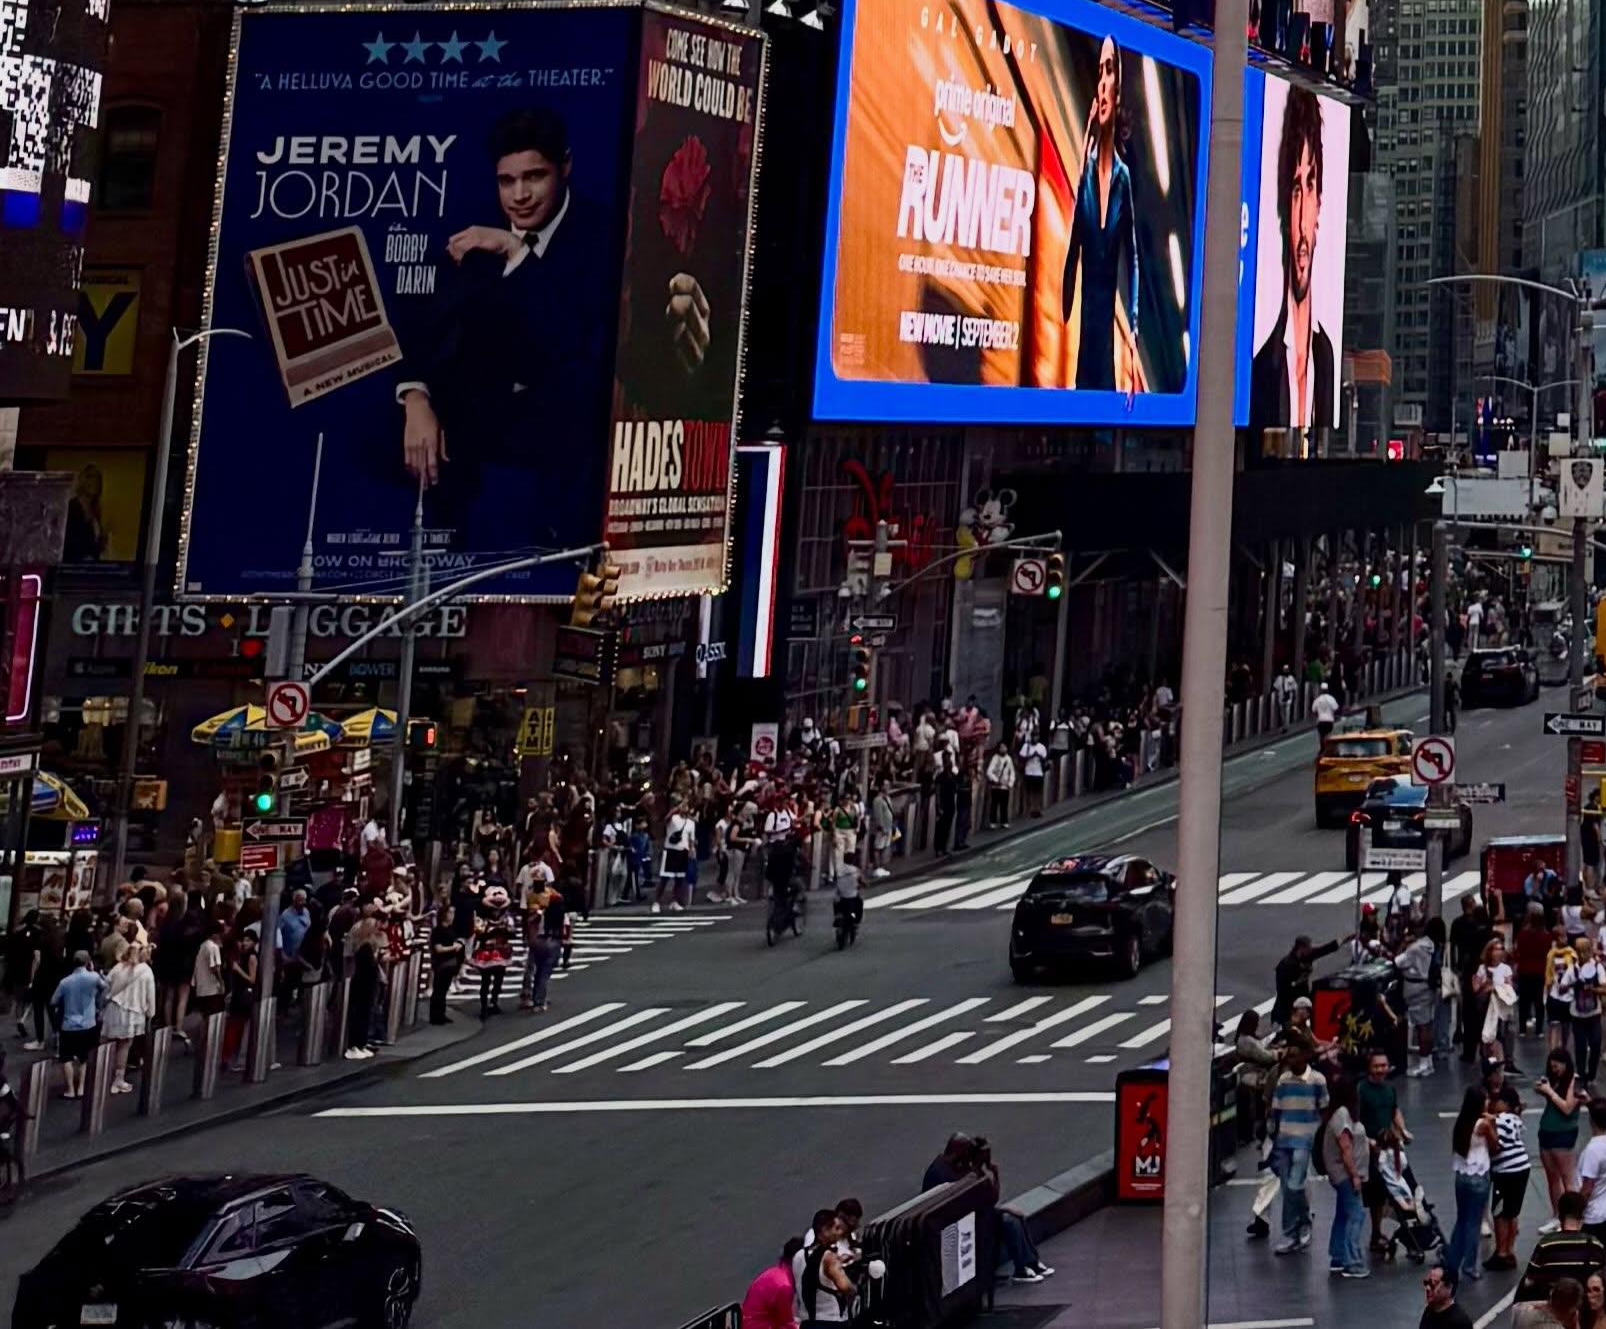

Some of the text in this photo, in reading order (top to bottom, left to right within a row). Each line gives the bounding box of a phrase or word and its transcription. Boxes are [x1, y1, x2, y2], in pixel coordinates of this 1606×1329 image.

[920, 6, 1038, 63] GAL GADOT
[278, 71, 352, 91] HELLUVA
[359, 71, 423, 90] GOOD
[430, 70, 470, 89] TIME
[495, 71, 524, 89] the
[647, 59, 693, 108] WORLD
[694, 72, 735, 119] COULD
[934, 78, 1017, 132] prime original
[256, 134, 458, 165] JEREMY
[249, 169, 448, 219] JORDAN
[896, 144, 1036, 257] RUNNER
[384, 233, 429, 263] BOBBY
[274, 251, 360, 308] JUST in
[395, 264, 437, 295] DARIN
[275, 284, 380, 342] TIME
[900, 311, 924, 342] NEW
[924, 313, 955, 345] MOVIE
[962, 316, 1012, 350] SEPTEMBER
[316, 373, 344, 390] NEW
[347, 353, 395, 378] MUSICAL
[313, 554, 343, 568] OW
[348, 554, 374, 567] ON
[244, 605, 469, 638] LGGAGE
[1135, 1155, 1160, 1174] MJ
